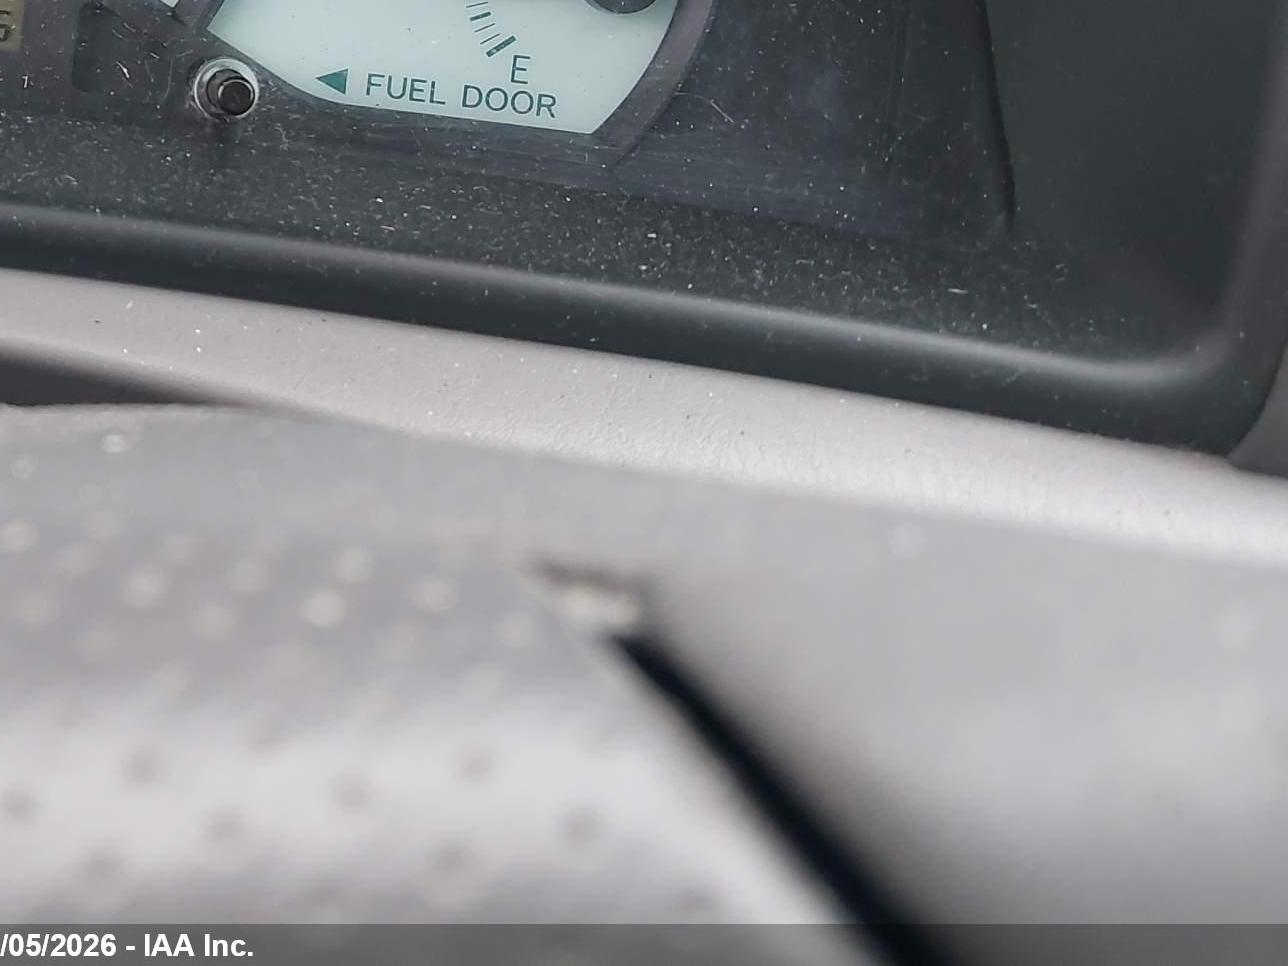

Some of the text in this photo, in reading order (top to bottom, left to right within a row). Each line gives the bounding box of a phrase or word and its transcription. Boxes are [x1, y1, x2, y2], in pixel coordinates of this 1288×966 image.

[511, 55, 531, 84] E
[366, 73, 558, 119] FUEL DOOR
